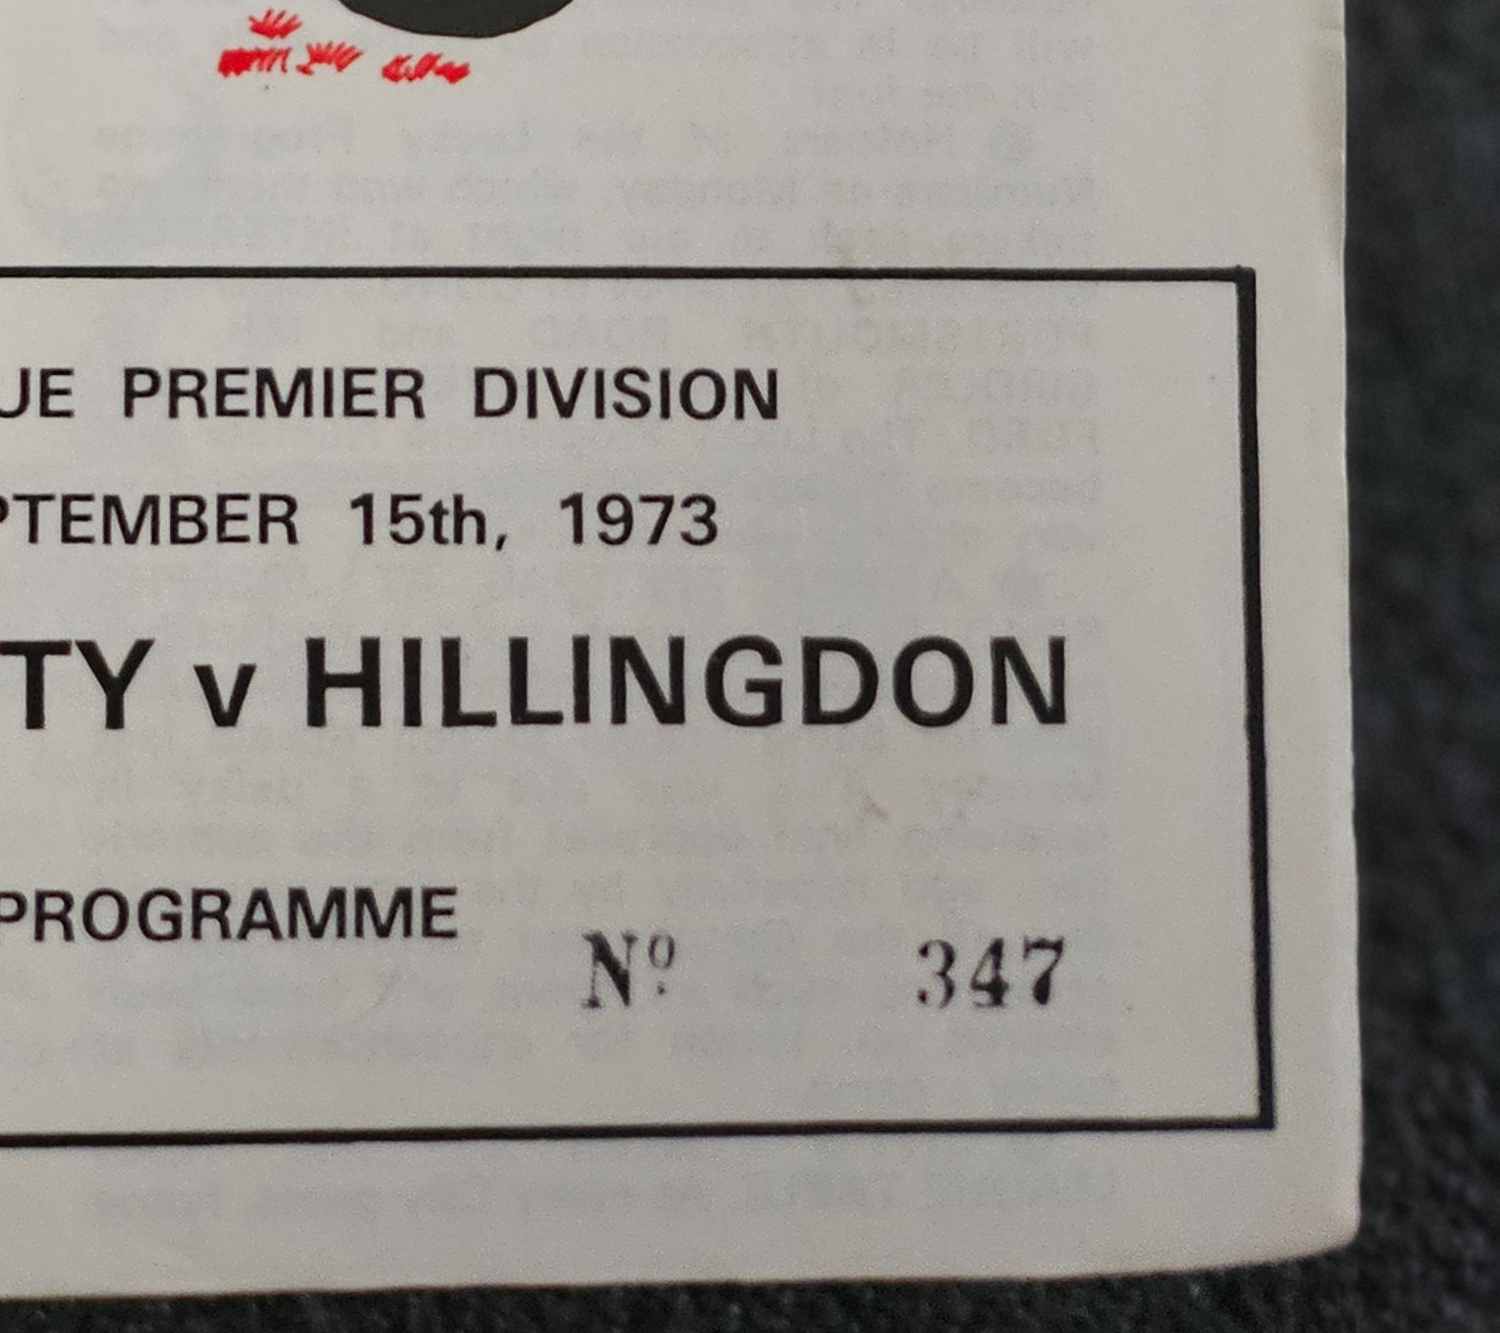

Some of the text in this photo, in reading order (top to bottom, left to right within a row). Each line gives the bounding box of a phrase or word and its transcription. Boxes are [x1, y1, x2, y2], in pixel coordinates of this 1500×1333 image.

[124, 368, 425, 419] PREMIER
[475, 368, 777, 420] DIVISION
[351, 494, 506, 551] 15th,
[561, 493, 717, 546] 1973
[194, 664, 256, 727] v
[306, 635, 1066, 728] HILLINGDON
[916, 936, 1066, 1009] 347
